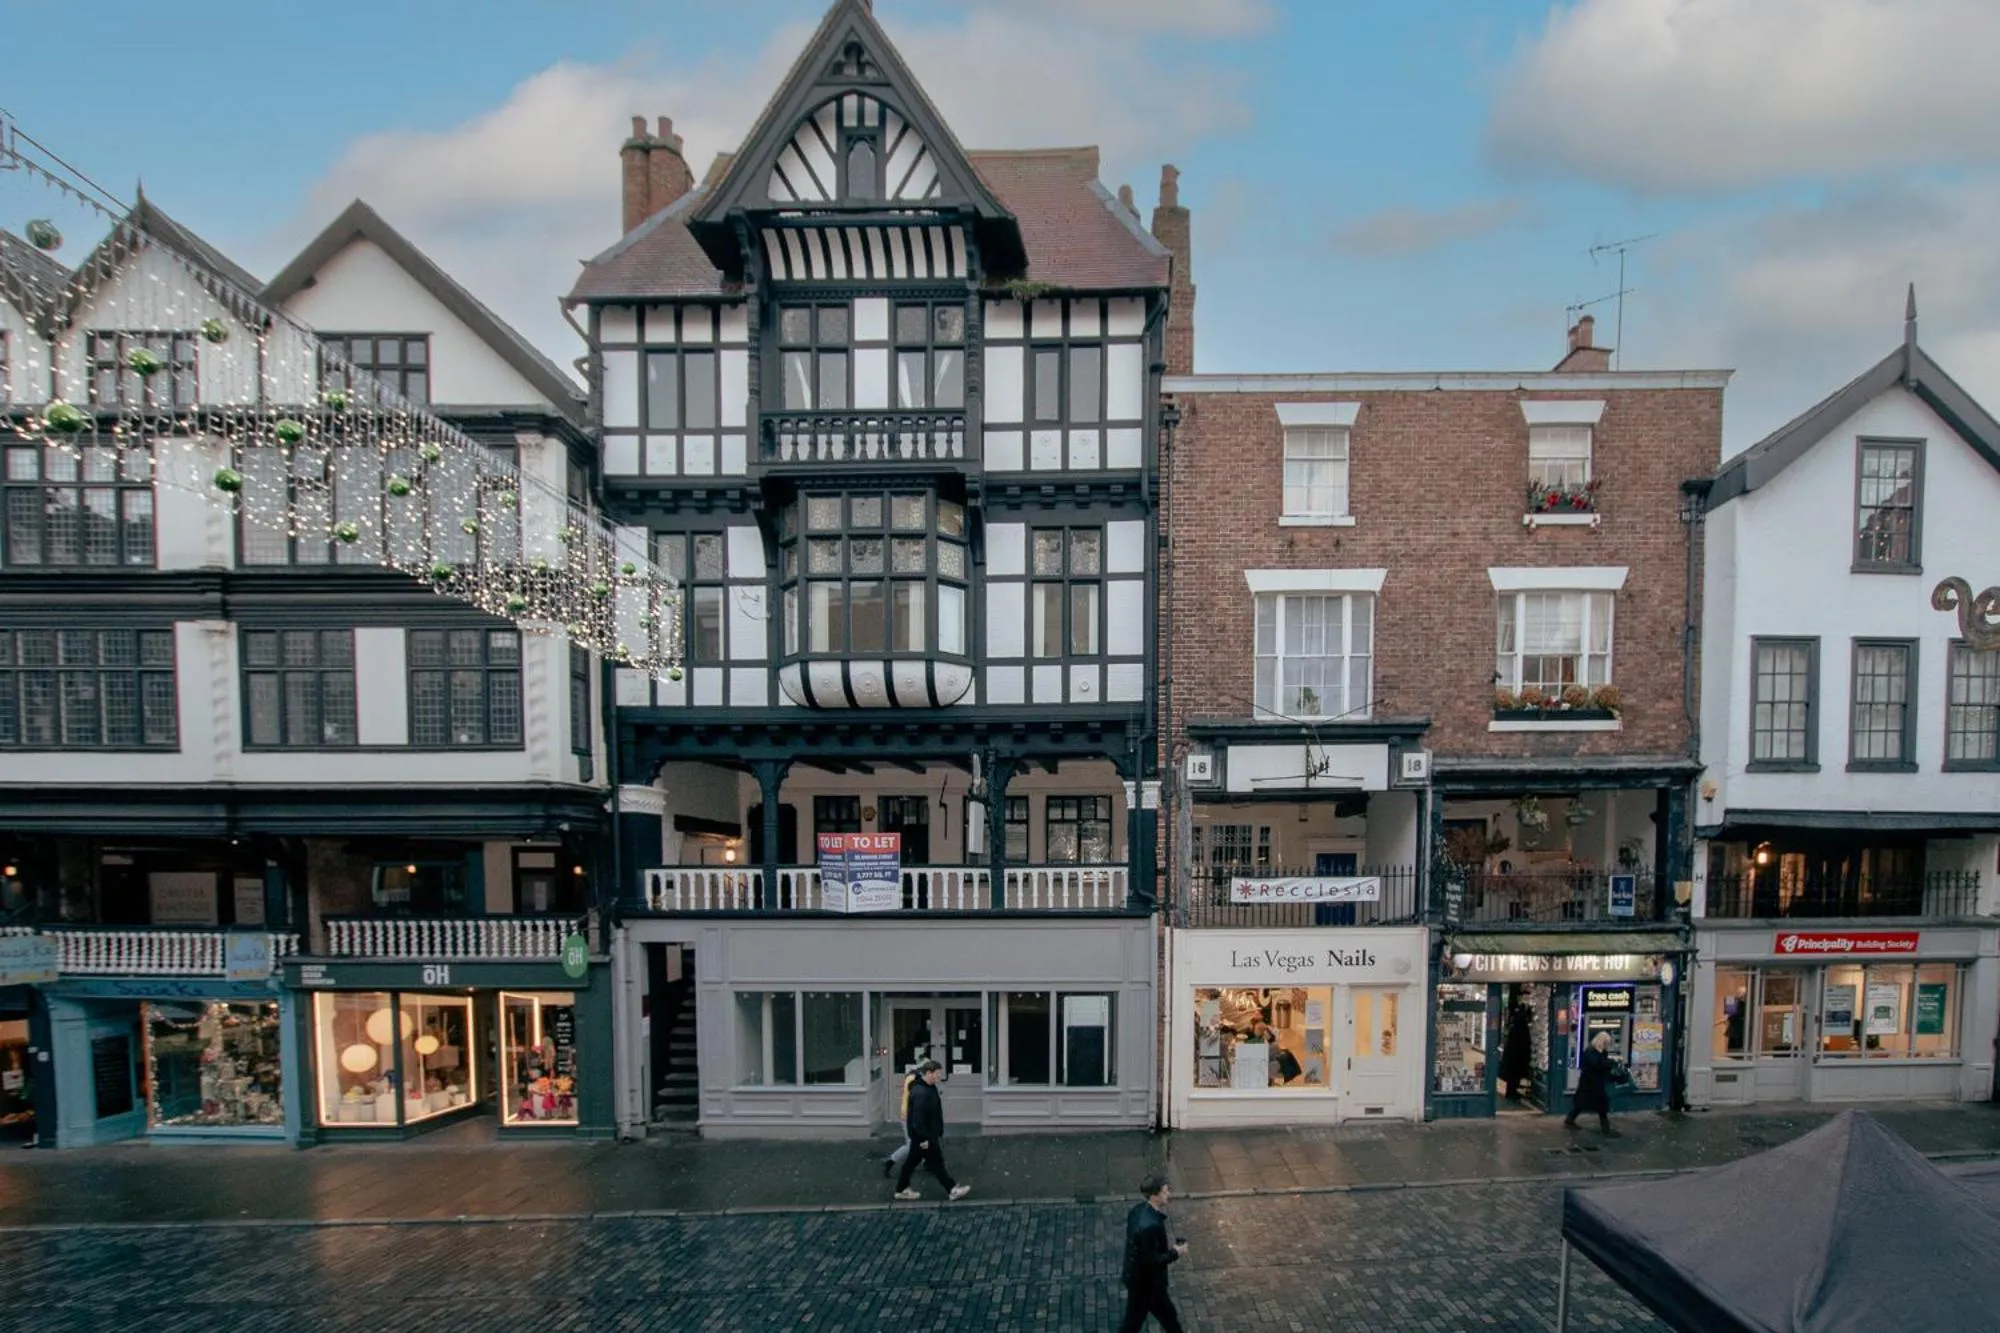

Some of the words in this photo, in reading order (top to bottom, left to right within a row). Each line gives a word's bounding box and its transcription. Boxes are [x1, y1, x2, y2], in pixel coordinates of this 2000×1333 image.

[1191, 760, 1207, 774] 18
[1407, 759, 1422, 772] 18
[820, 836, 830, 849] TO
[831, 836, 843, 849] LET
[852, 836, 870, 849] TO
[874, 836, 896, 849] LET
[1259, 883, 1376, 897] Recclesia
[1797, 936, 1854, 951] Principality
[1231, 950, 1261, 968] Las
[1264, 950, 1315, 973] Vegas
[1327, 949, 1376, 968] Nails
[1475, 955, 1506, 972] CITY
[1509, 955, 1550, 972] NEWS
[1553, 956, 1563, 970] &
[1566, 955, 1601, 971] VAPE
[1588, 991, 1607, 1001] free
[1608, 991, 1630, 1001] cash
